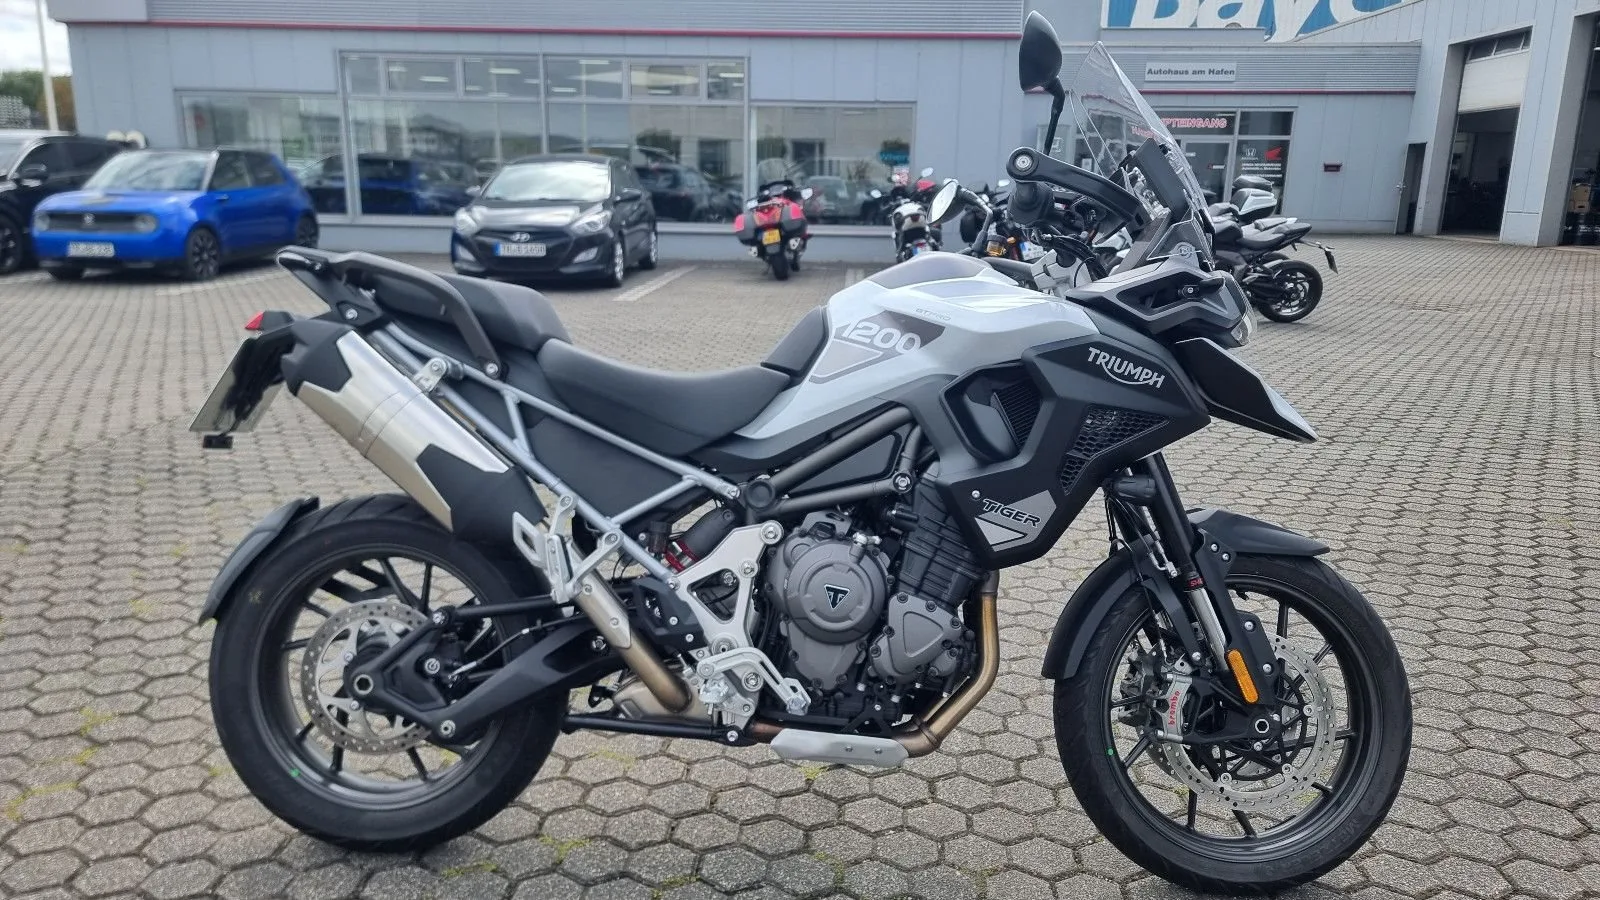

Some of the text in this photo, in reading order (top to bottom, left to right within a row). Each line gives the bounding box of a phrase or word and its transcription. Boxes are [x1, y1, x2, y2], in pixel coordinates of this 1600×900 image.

[1147, 68, 1189, 76] Autohaus
[1208, 68, 1235, 76] Hafen
[842, 320, 921, 354] 1200
[1087, 347, 1165, 389] TRIUMPH
[983, 498, 1041, 528] TIGER
[1168, 690, 1180, 726] brembo
